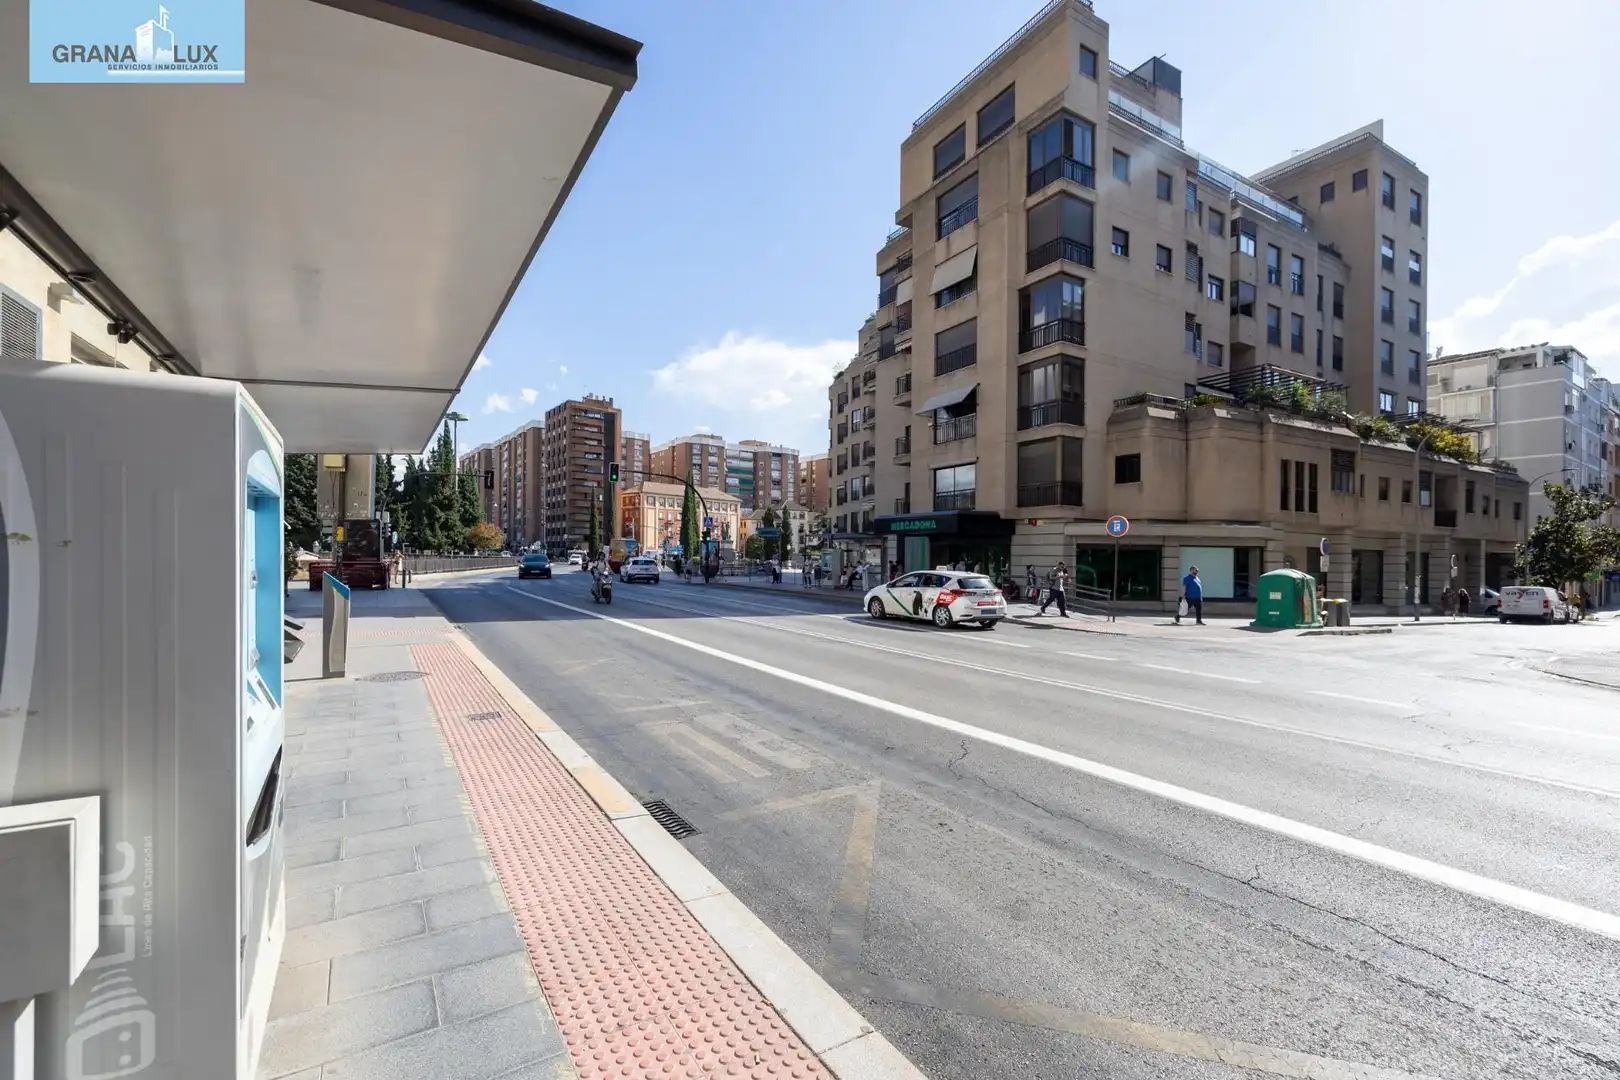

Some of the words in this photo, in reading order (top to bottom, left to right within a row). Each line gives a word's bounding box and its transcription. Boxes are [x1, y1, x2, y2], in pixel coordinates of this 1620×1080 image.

[890, 519, 936, 531] MERCADONA
[142, 836, 153, 888] Capacidad
[142, 890, 153, 911] Alta
[142, 914, 153, 927] de
